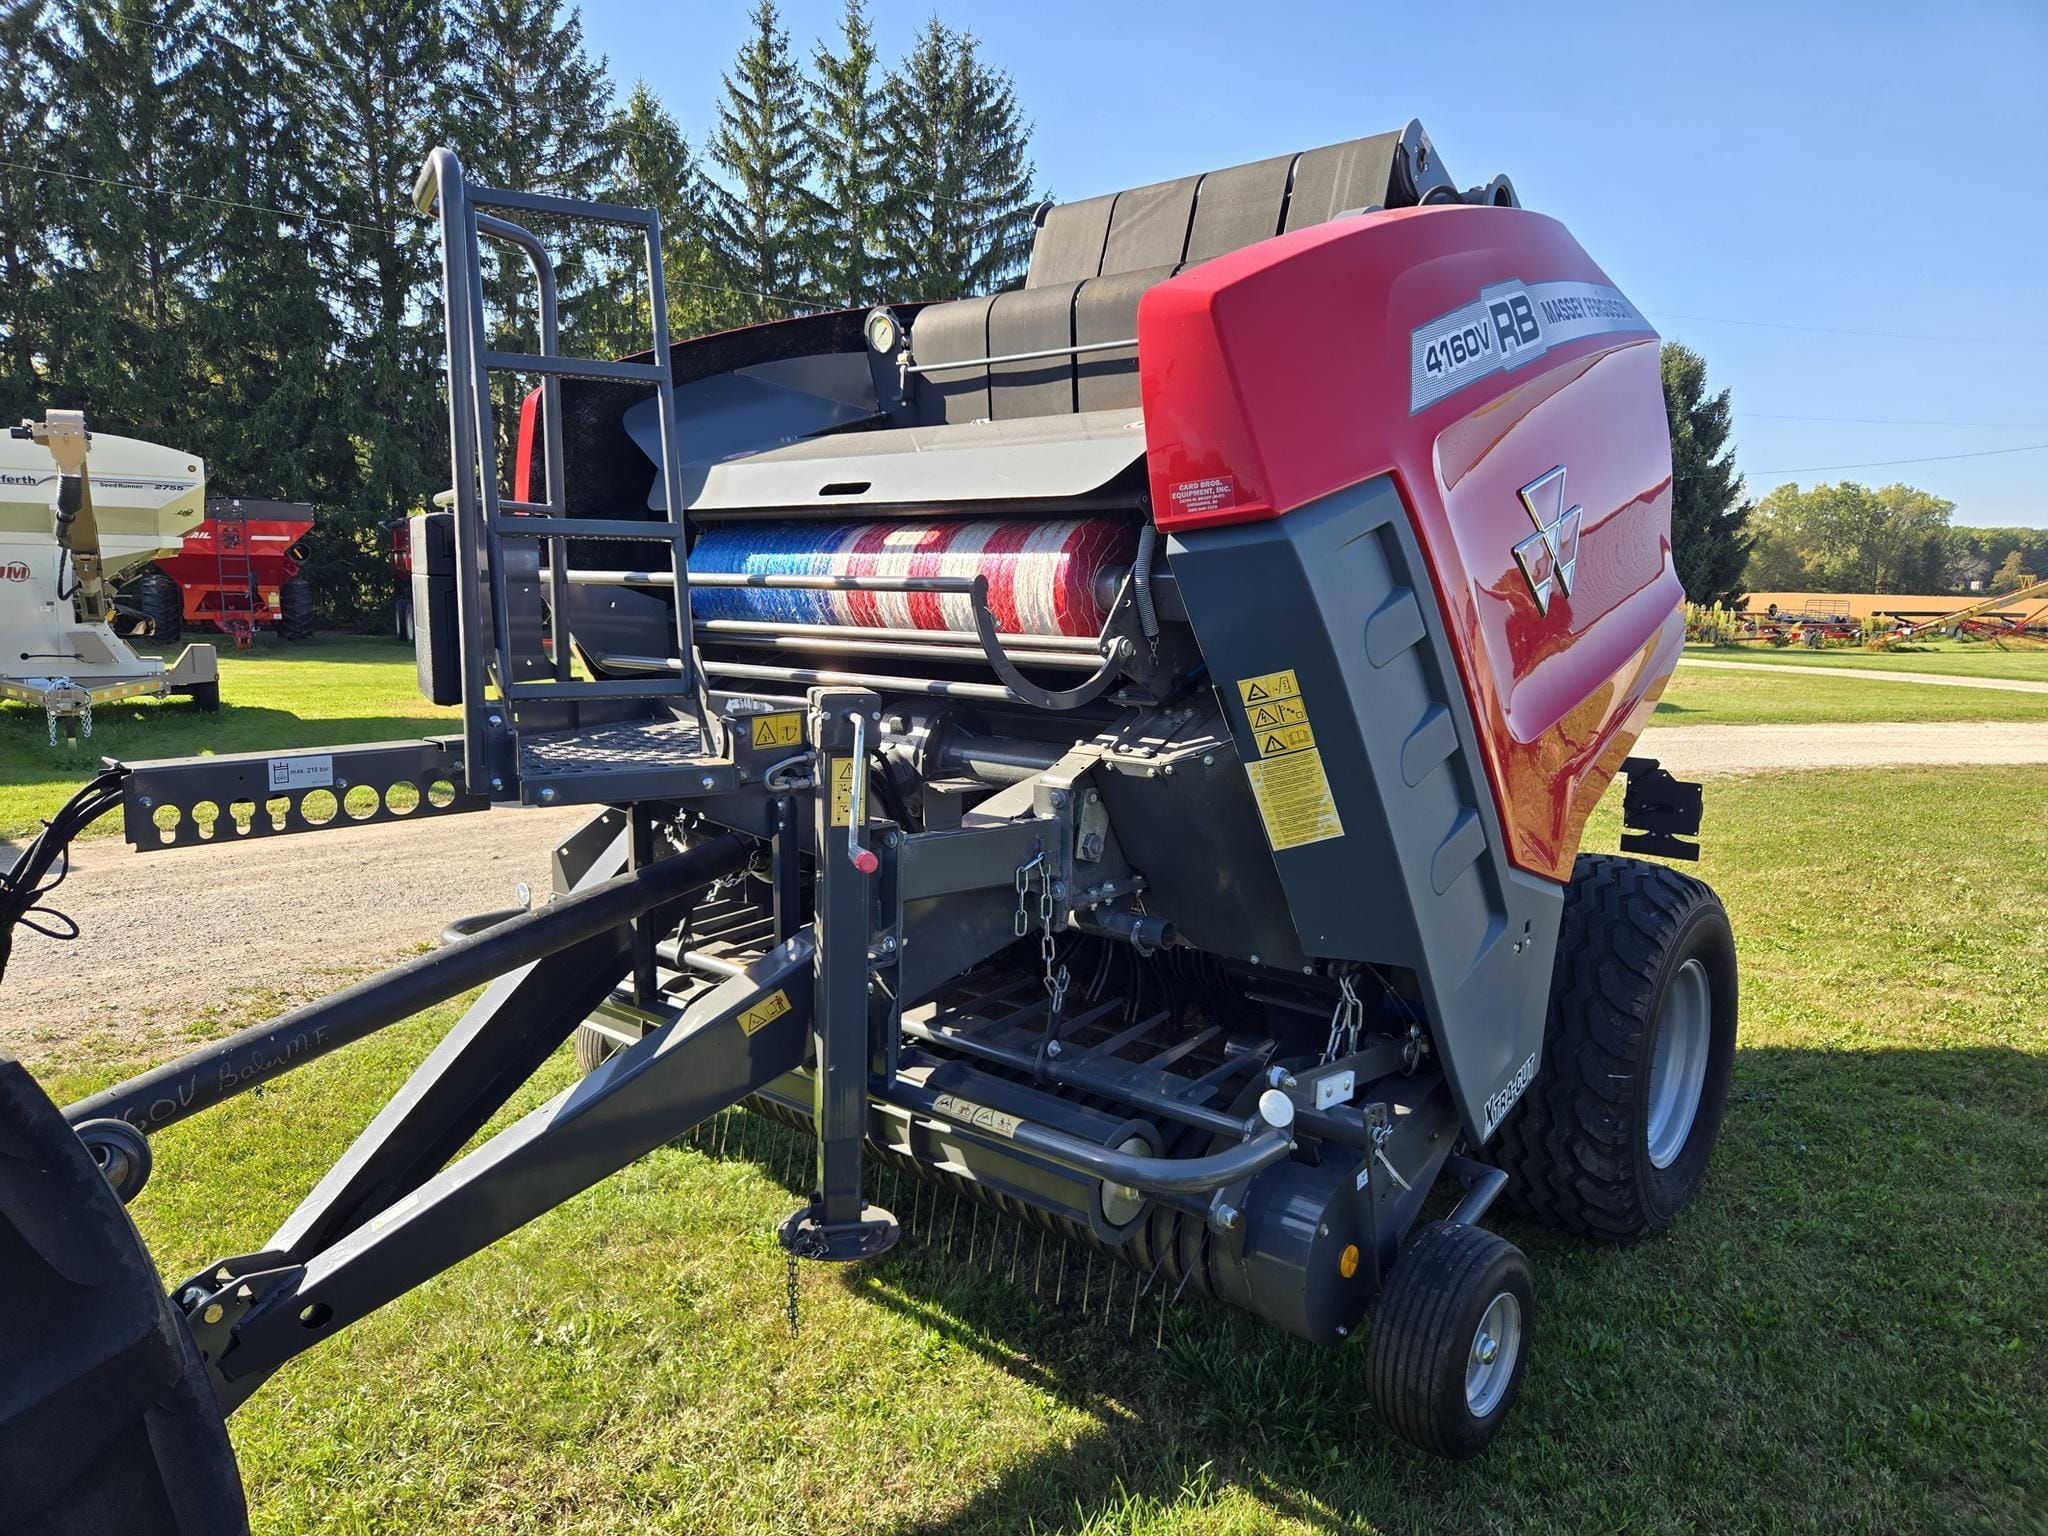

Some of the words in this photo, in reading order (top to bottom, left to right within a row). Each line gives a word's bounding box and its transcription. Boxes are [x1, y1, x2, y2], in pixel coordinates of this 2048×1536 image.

[1425, 322, 1491, 374] 4160V
[1488, 294, 1540, 354] RB
[1540, 297, 1587, 325] MASSEY
[1583, 297, 1633, 320] FERGUSON
[0, 474, 36, 485] ferth
[1178, 482, 1199, 491] CARD
[1200, 479, 1223, 488] BROS.
[1172, 487, 1215, 500] EQUIPMENT,
[1216, 485, 1232, 494] INC.
